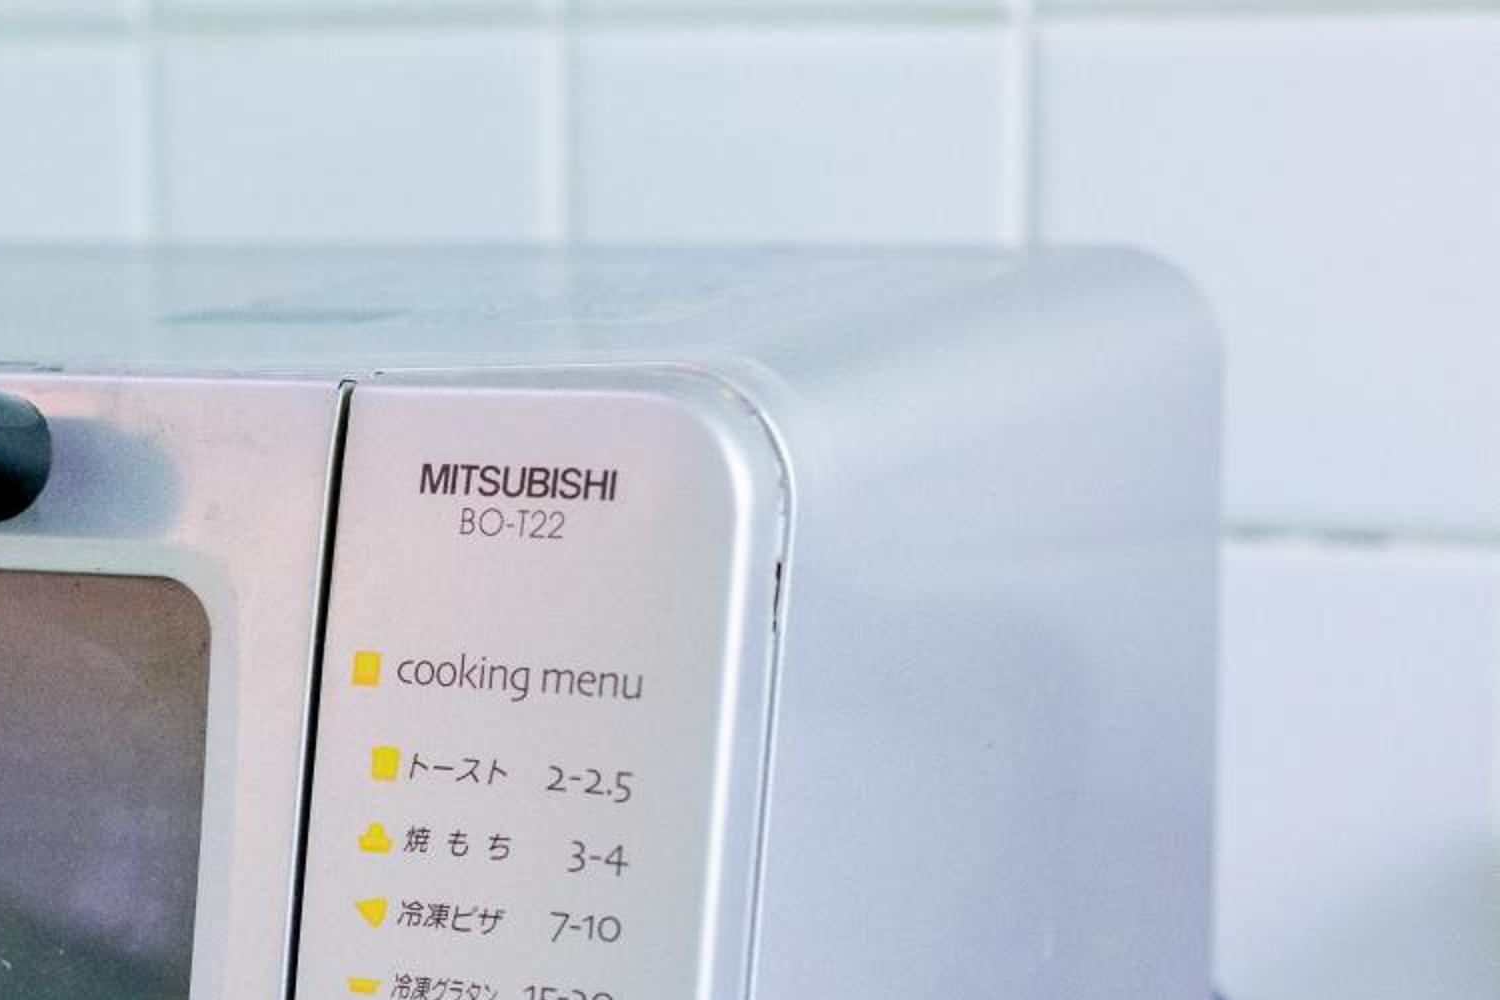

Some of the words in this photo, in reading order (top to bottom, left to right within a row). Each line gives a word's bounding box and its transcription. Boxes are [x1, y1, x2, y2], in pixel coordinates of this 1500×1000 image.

[419, 463, 618, 501] MITSUBISHI
[459, 507, 566, 540] BO-T22
[397, 653, 530, 702] cooking
[541, 666, 643, 700] menu
[408, 752, 508, 785] トースト
[546, 766, 634, 803] 2-2.5
[567, 841, 629, 876] 3-4
[396, 900, 506, 936] 冷凍ピザ
[550, 912, 622, 943] 7-10
